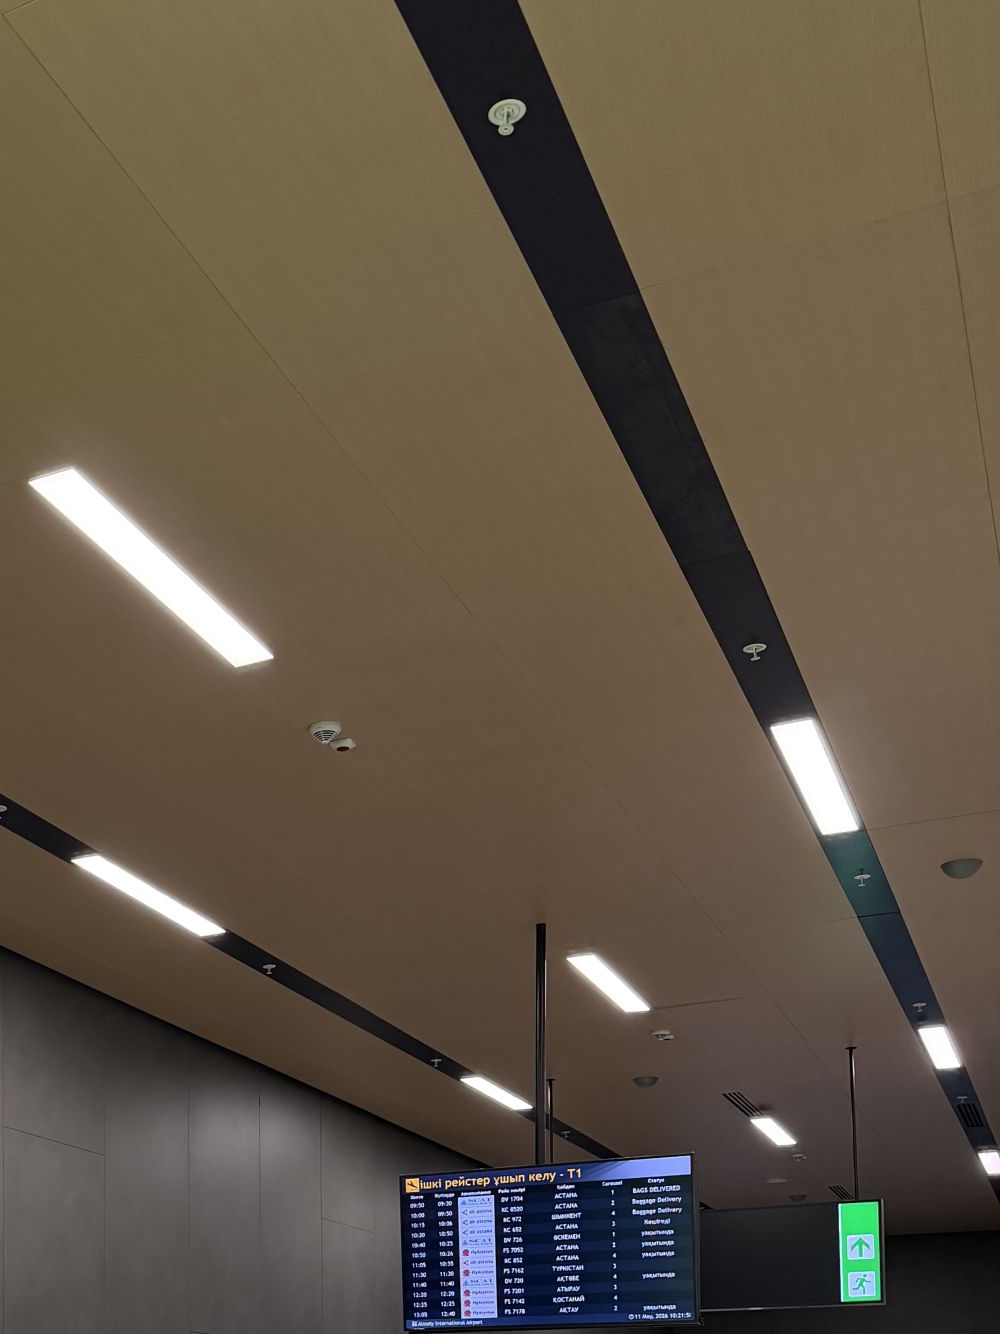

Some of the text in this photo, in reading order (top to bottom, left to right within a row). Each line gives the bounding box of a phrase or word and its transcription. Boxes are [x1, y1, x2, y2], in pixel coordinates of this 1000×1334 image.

[445, 1176, 491, 1190] рейстер
[493, 1174, 525, 1186] ұшып
[528, 1172, 556, 1183] келу
[567, 1168, 581, 1179] T1
[649, 1184, 681, 1193] DELIVERED
[554, 1202, 578, 1210] АСТАНА
[631, 1198, 656, 1206] Baggage
